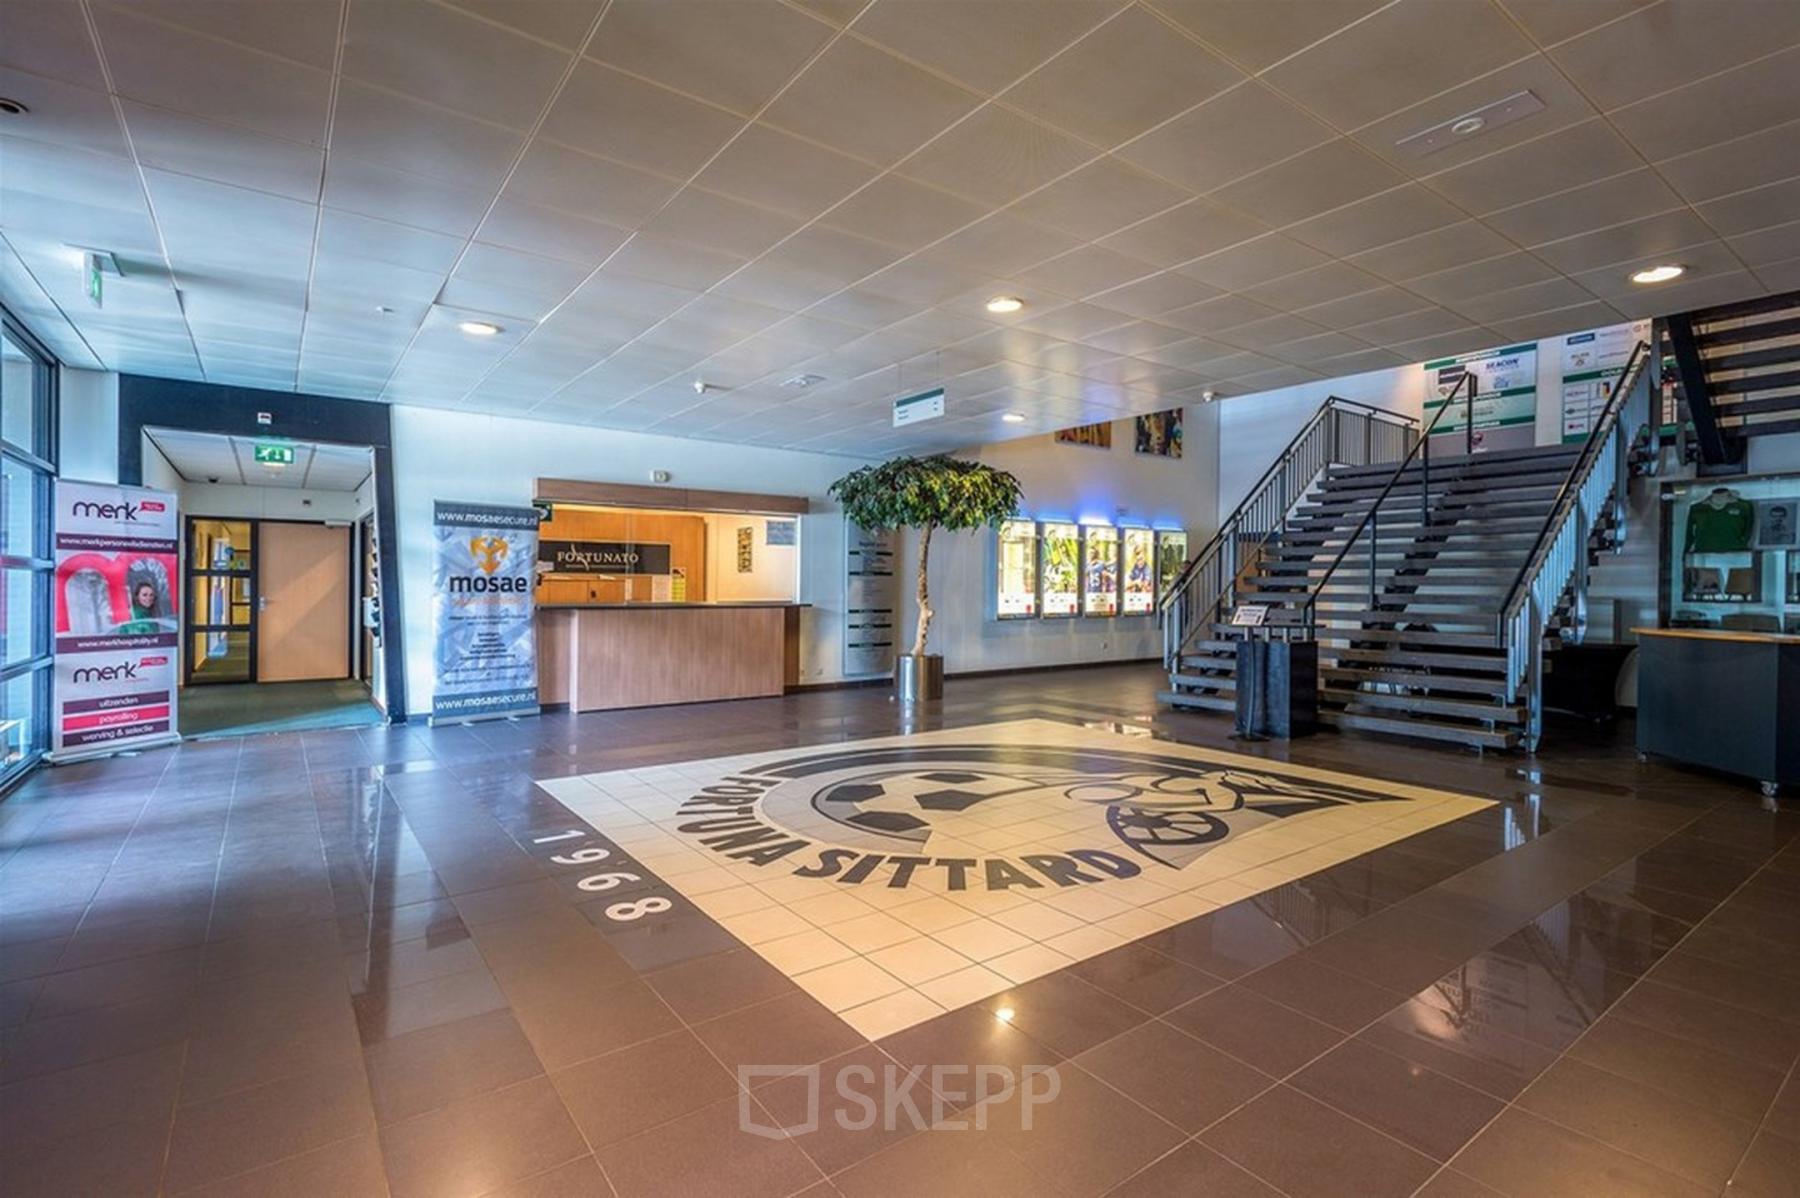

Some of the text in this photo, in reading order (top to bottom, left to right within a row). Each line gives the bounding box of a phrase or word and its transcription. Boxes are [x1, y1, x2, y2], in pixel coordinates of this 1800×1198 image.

[73, 501, 137, 520] merk
[437, 512, 538, 526] www.mosaesecure.nl
[557, 545, 639, 569] FORTUNATO
[449, 576, 527, 593] mosae
[73, 661, 136, 683] merk
[98, 696, 139, 708] uitzenden
[435, 691, 537, 709] www.mosaesecure.nl
[99, 712, 138, 725] payrolling
[81, 730, 115, 742] werving
[125, 724, 154, 736] selectie
[675, 776, 1142, 891] FORTUNA SITTARD
[533, 829, 673, 922] 1968
